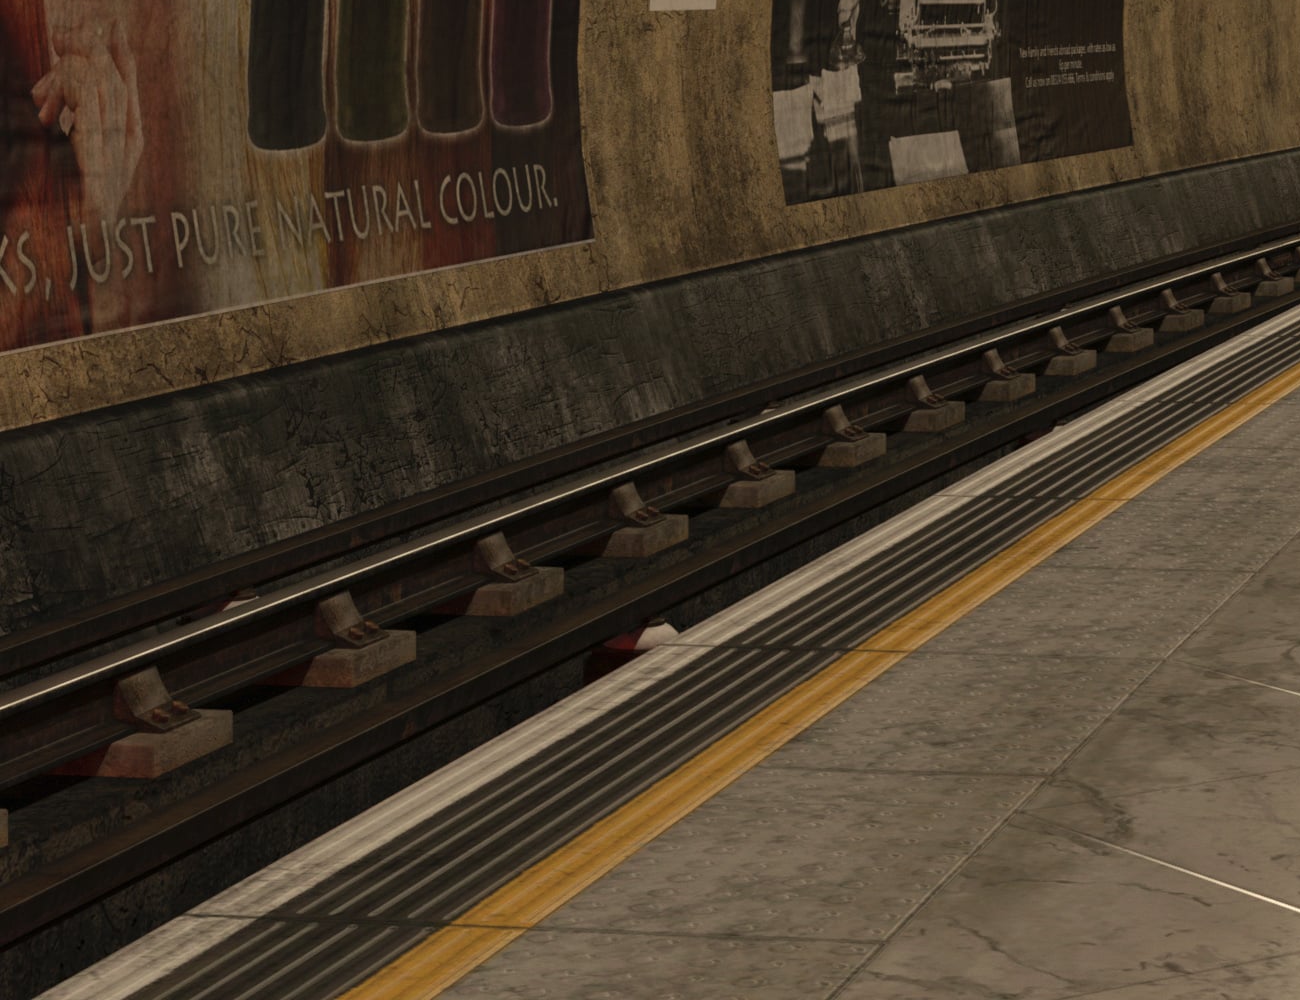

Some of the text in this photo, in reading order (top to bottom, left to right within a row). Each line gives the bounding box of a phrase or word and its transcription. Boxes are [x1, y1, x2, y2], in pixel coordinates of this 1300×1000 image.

[66, 215, 157, 291] JUST
[171, 199, 264, 269] PURE
[276, 179, 432, 248] NATURAL
[438, 163, 559, 227] COLOUR.
